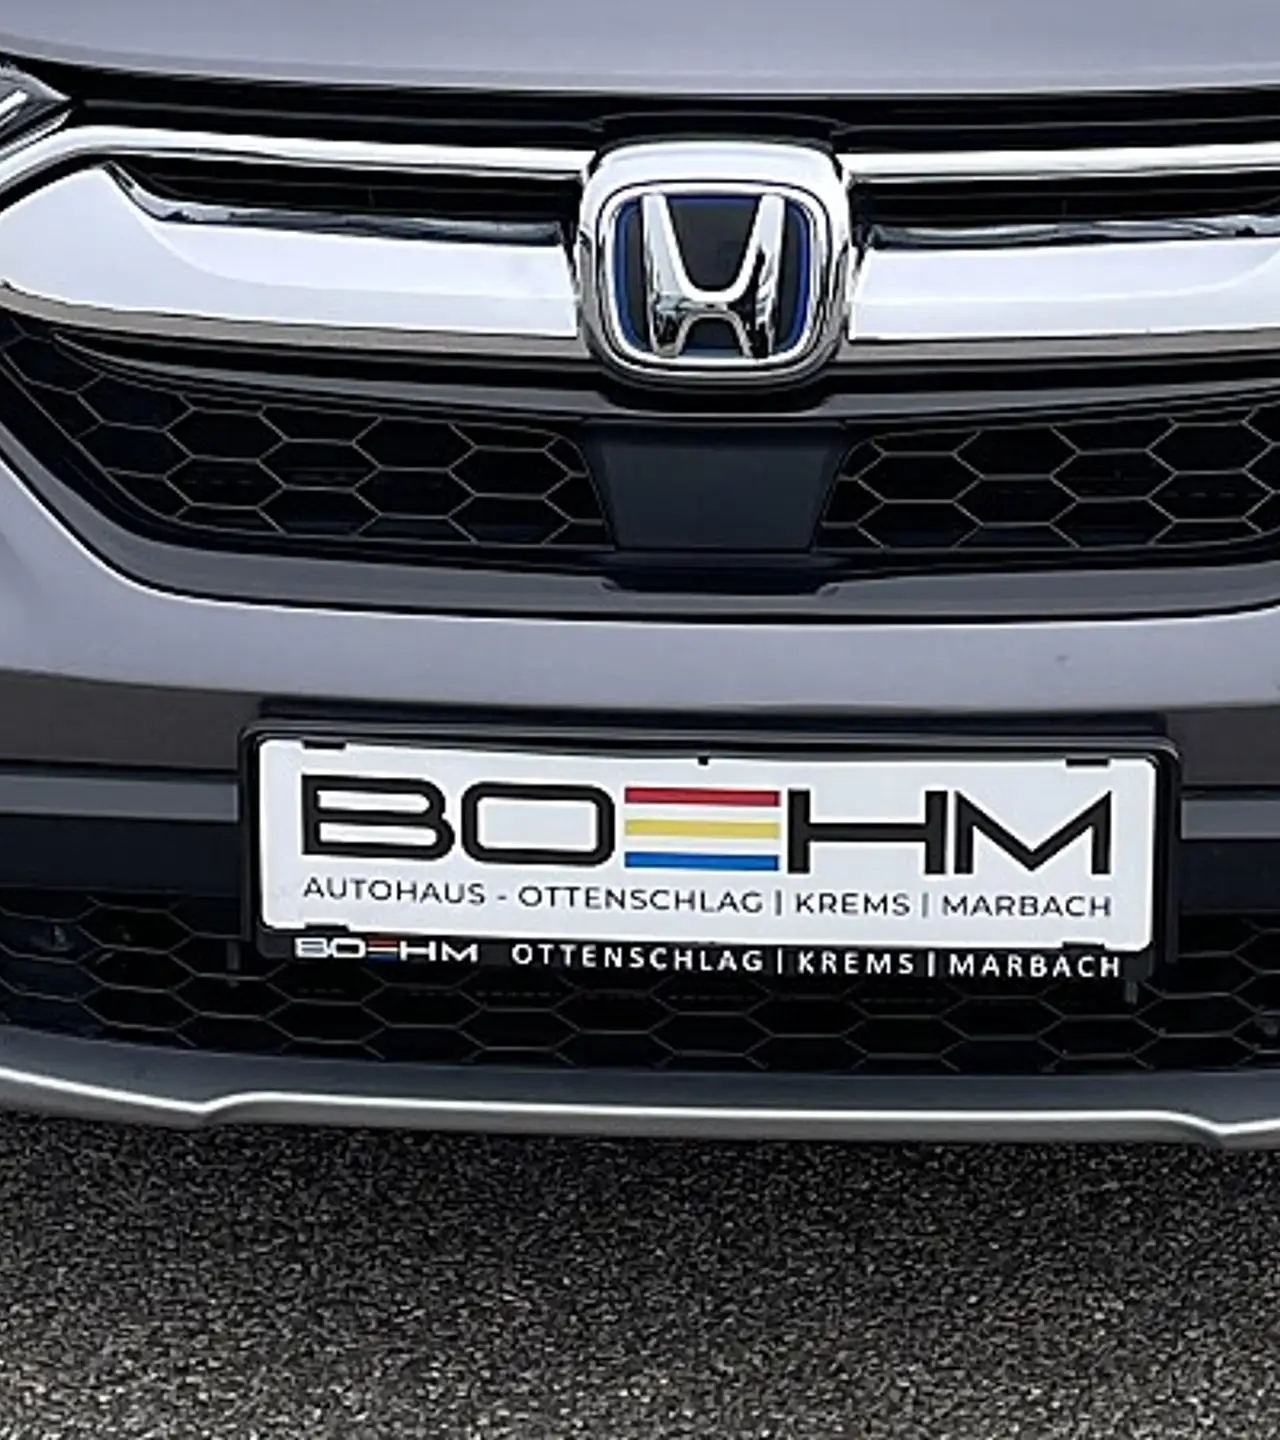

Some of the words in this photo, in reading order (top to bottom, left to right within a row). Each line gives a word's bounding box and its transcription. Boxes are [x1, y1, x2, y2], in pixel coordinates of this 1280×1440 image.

[302, 876, 486, 906] AUTOHAUS
[518, 885, 763, 914] OTTENSCHLAG
[795, 892, 911, 917] KREMS
[941, 894, 1112, 918] MARBACH
[511, 943, 763, 973] OTTENSCHLAG
[798, 951, 914, 976] KREMS
[948, 953, 1120, 978] MARBACH
